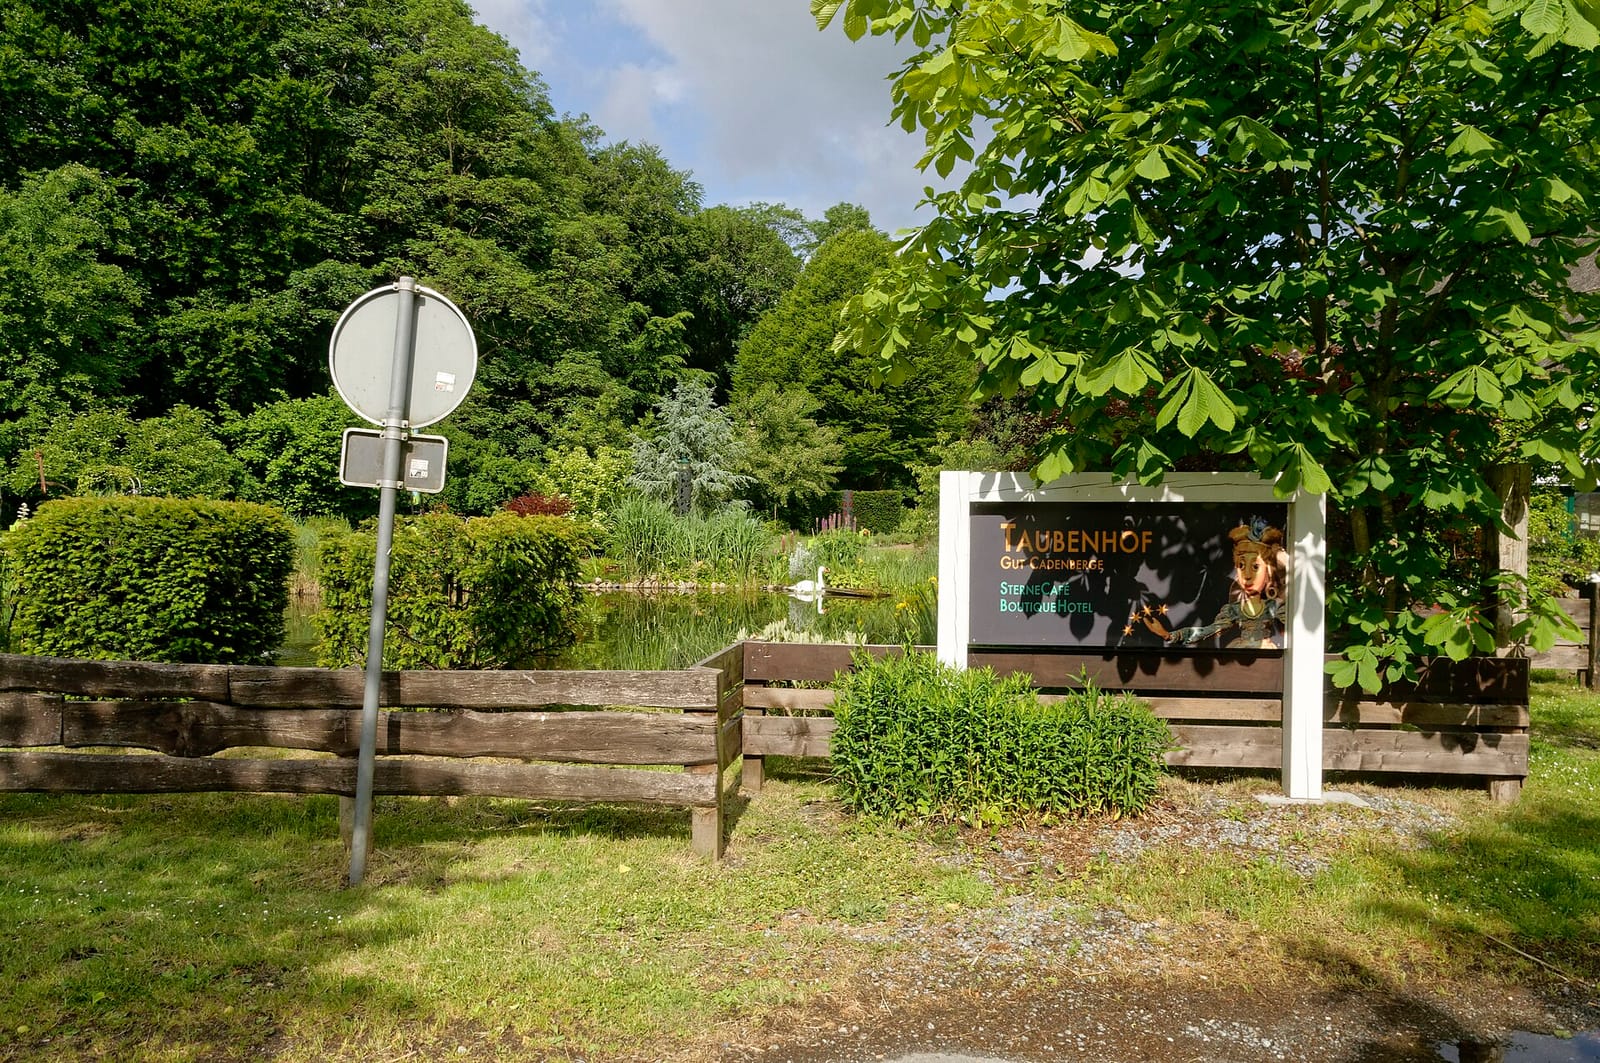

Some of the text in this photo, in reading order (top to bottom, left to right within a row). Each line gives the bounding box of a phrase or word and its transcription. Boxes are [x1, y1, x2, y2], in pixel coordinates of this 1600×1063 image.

[1000, 522, 1153, 554] TAUBENHOF
[1000, 555, 1104, 572] GUT CADENBERGE
